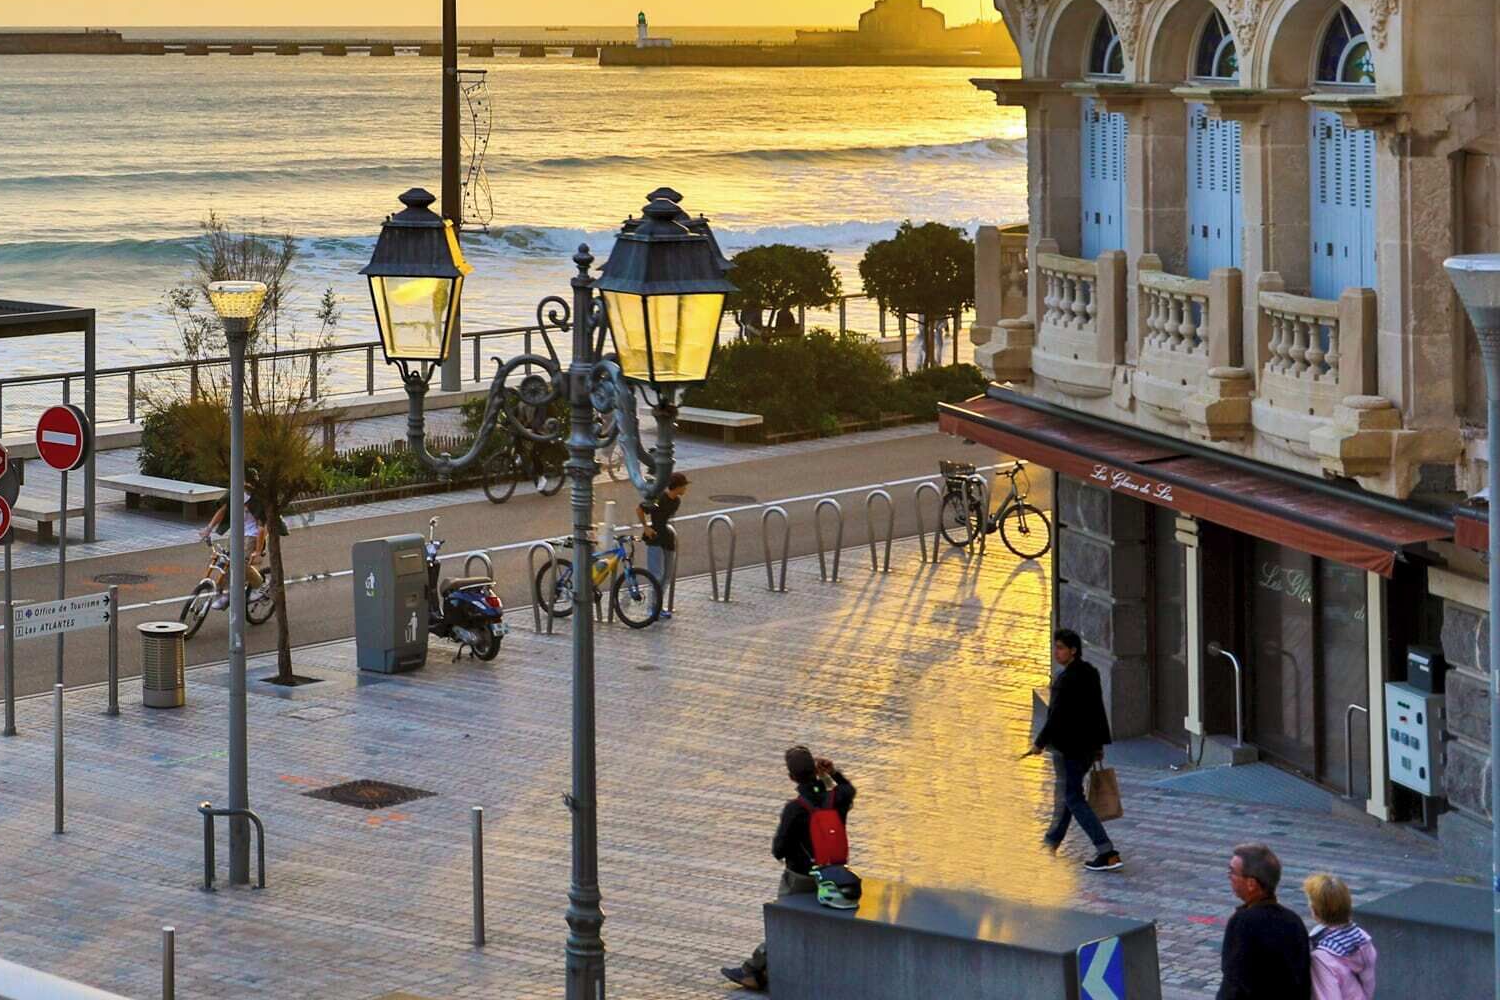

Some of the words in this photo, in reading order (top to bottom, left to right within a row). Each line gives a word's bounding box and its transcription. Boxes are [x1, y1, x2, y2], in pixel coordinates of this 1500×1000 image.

[34, 607, 56, 617] Office
[59, 604, 67, 612] de
[70, 599, 100, 609] Tourisme
[40, 618, 76, 632] ATLANTES
